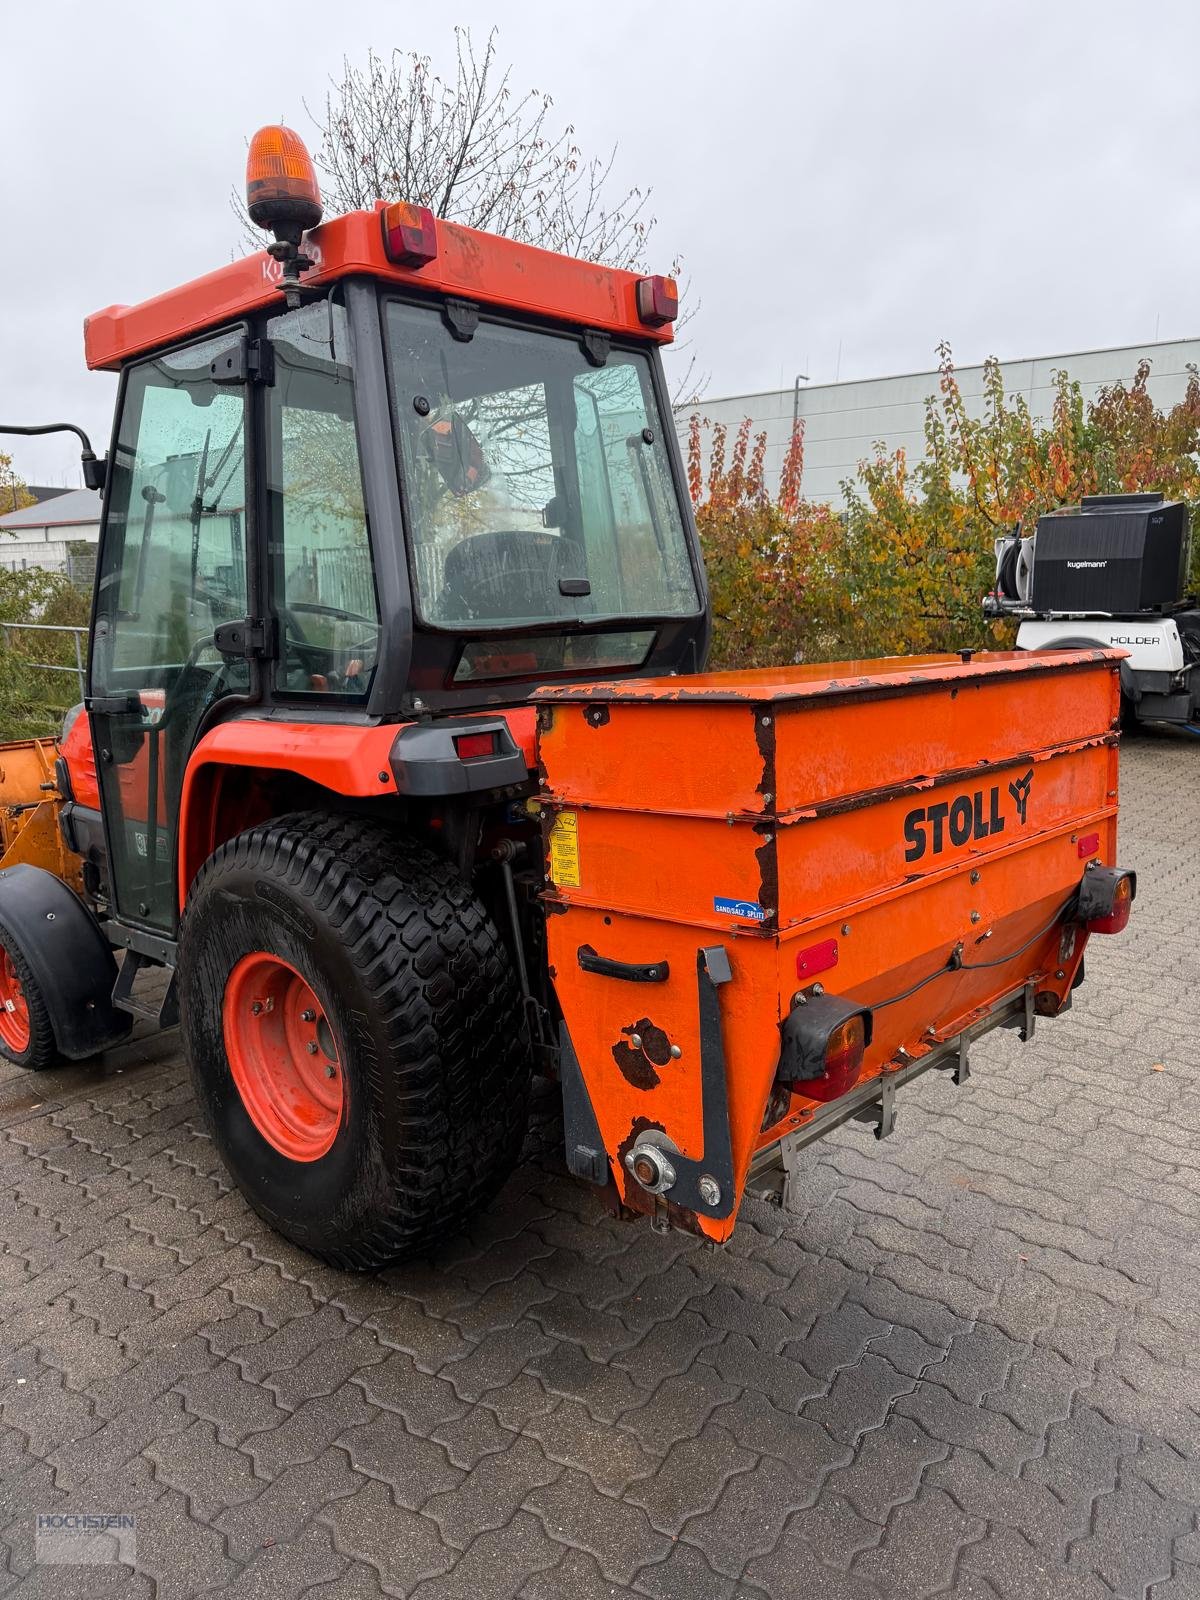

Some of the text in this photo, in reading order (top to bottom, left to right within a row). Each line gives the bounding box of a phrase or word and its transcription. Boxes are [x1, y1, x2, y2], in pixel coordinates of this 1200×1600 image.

[1067, 561, 1106, 570] kugelmann
[1110, 636, 1160, 645] HOLDER
[904, 786, 1005, 863] STOLL
[715, 905, 745, 917] SAND/SALZ
